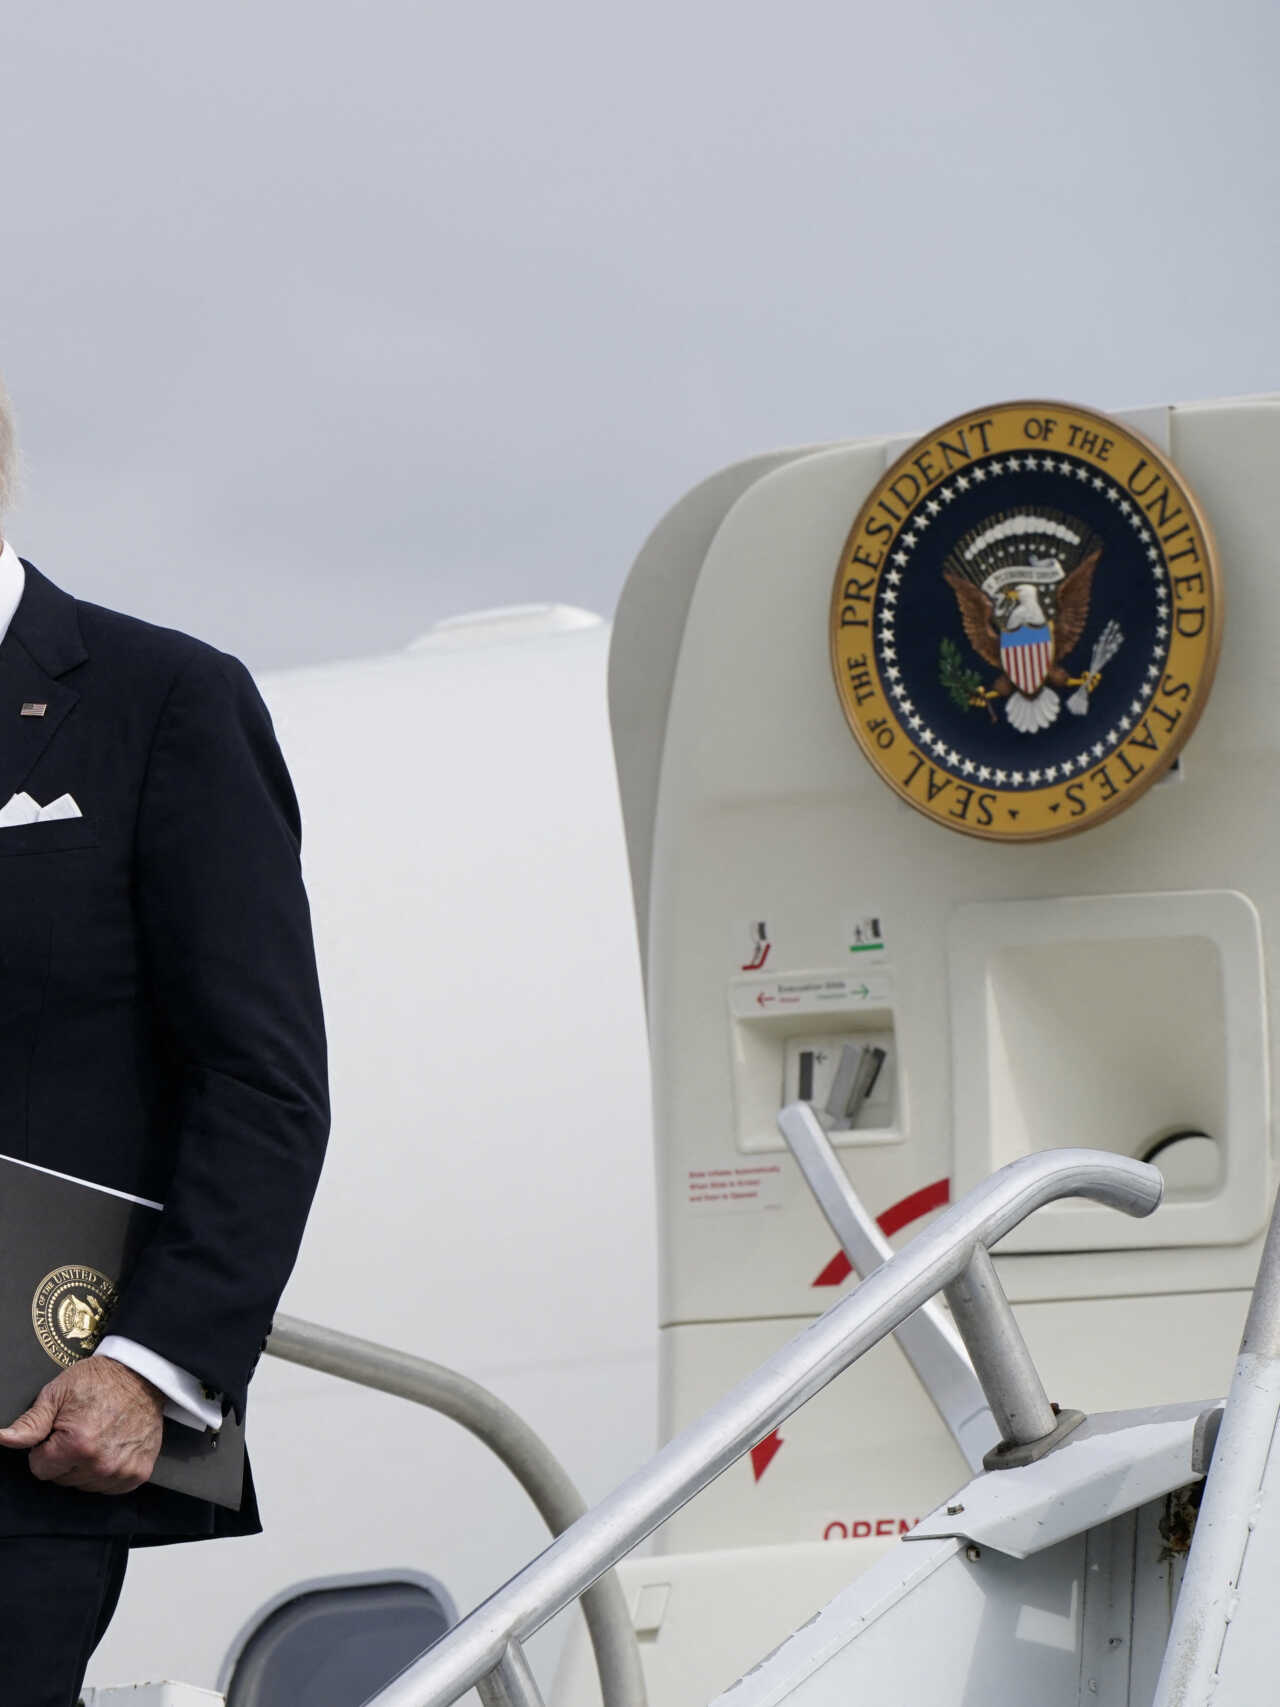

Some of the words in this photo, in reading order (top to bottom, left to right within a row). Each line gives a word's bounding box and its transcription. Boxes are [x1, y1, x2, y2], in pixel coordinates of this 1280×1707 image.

[1023, 417, 1057, 442] OF
[1068, 423, 1114, 461] THE
[840, 419, 993, 629] PRESIDENT
[1127, 458, 1206, 638] UNITED
[847, 653, 875, 706] THE
[867, 717, 895, 749] OF
[1065, 674, 1191, 816] STATES
[903, 749, 997, 826] SEAL
[53, 1269, 97, 1284] UNITED
